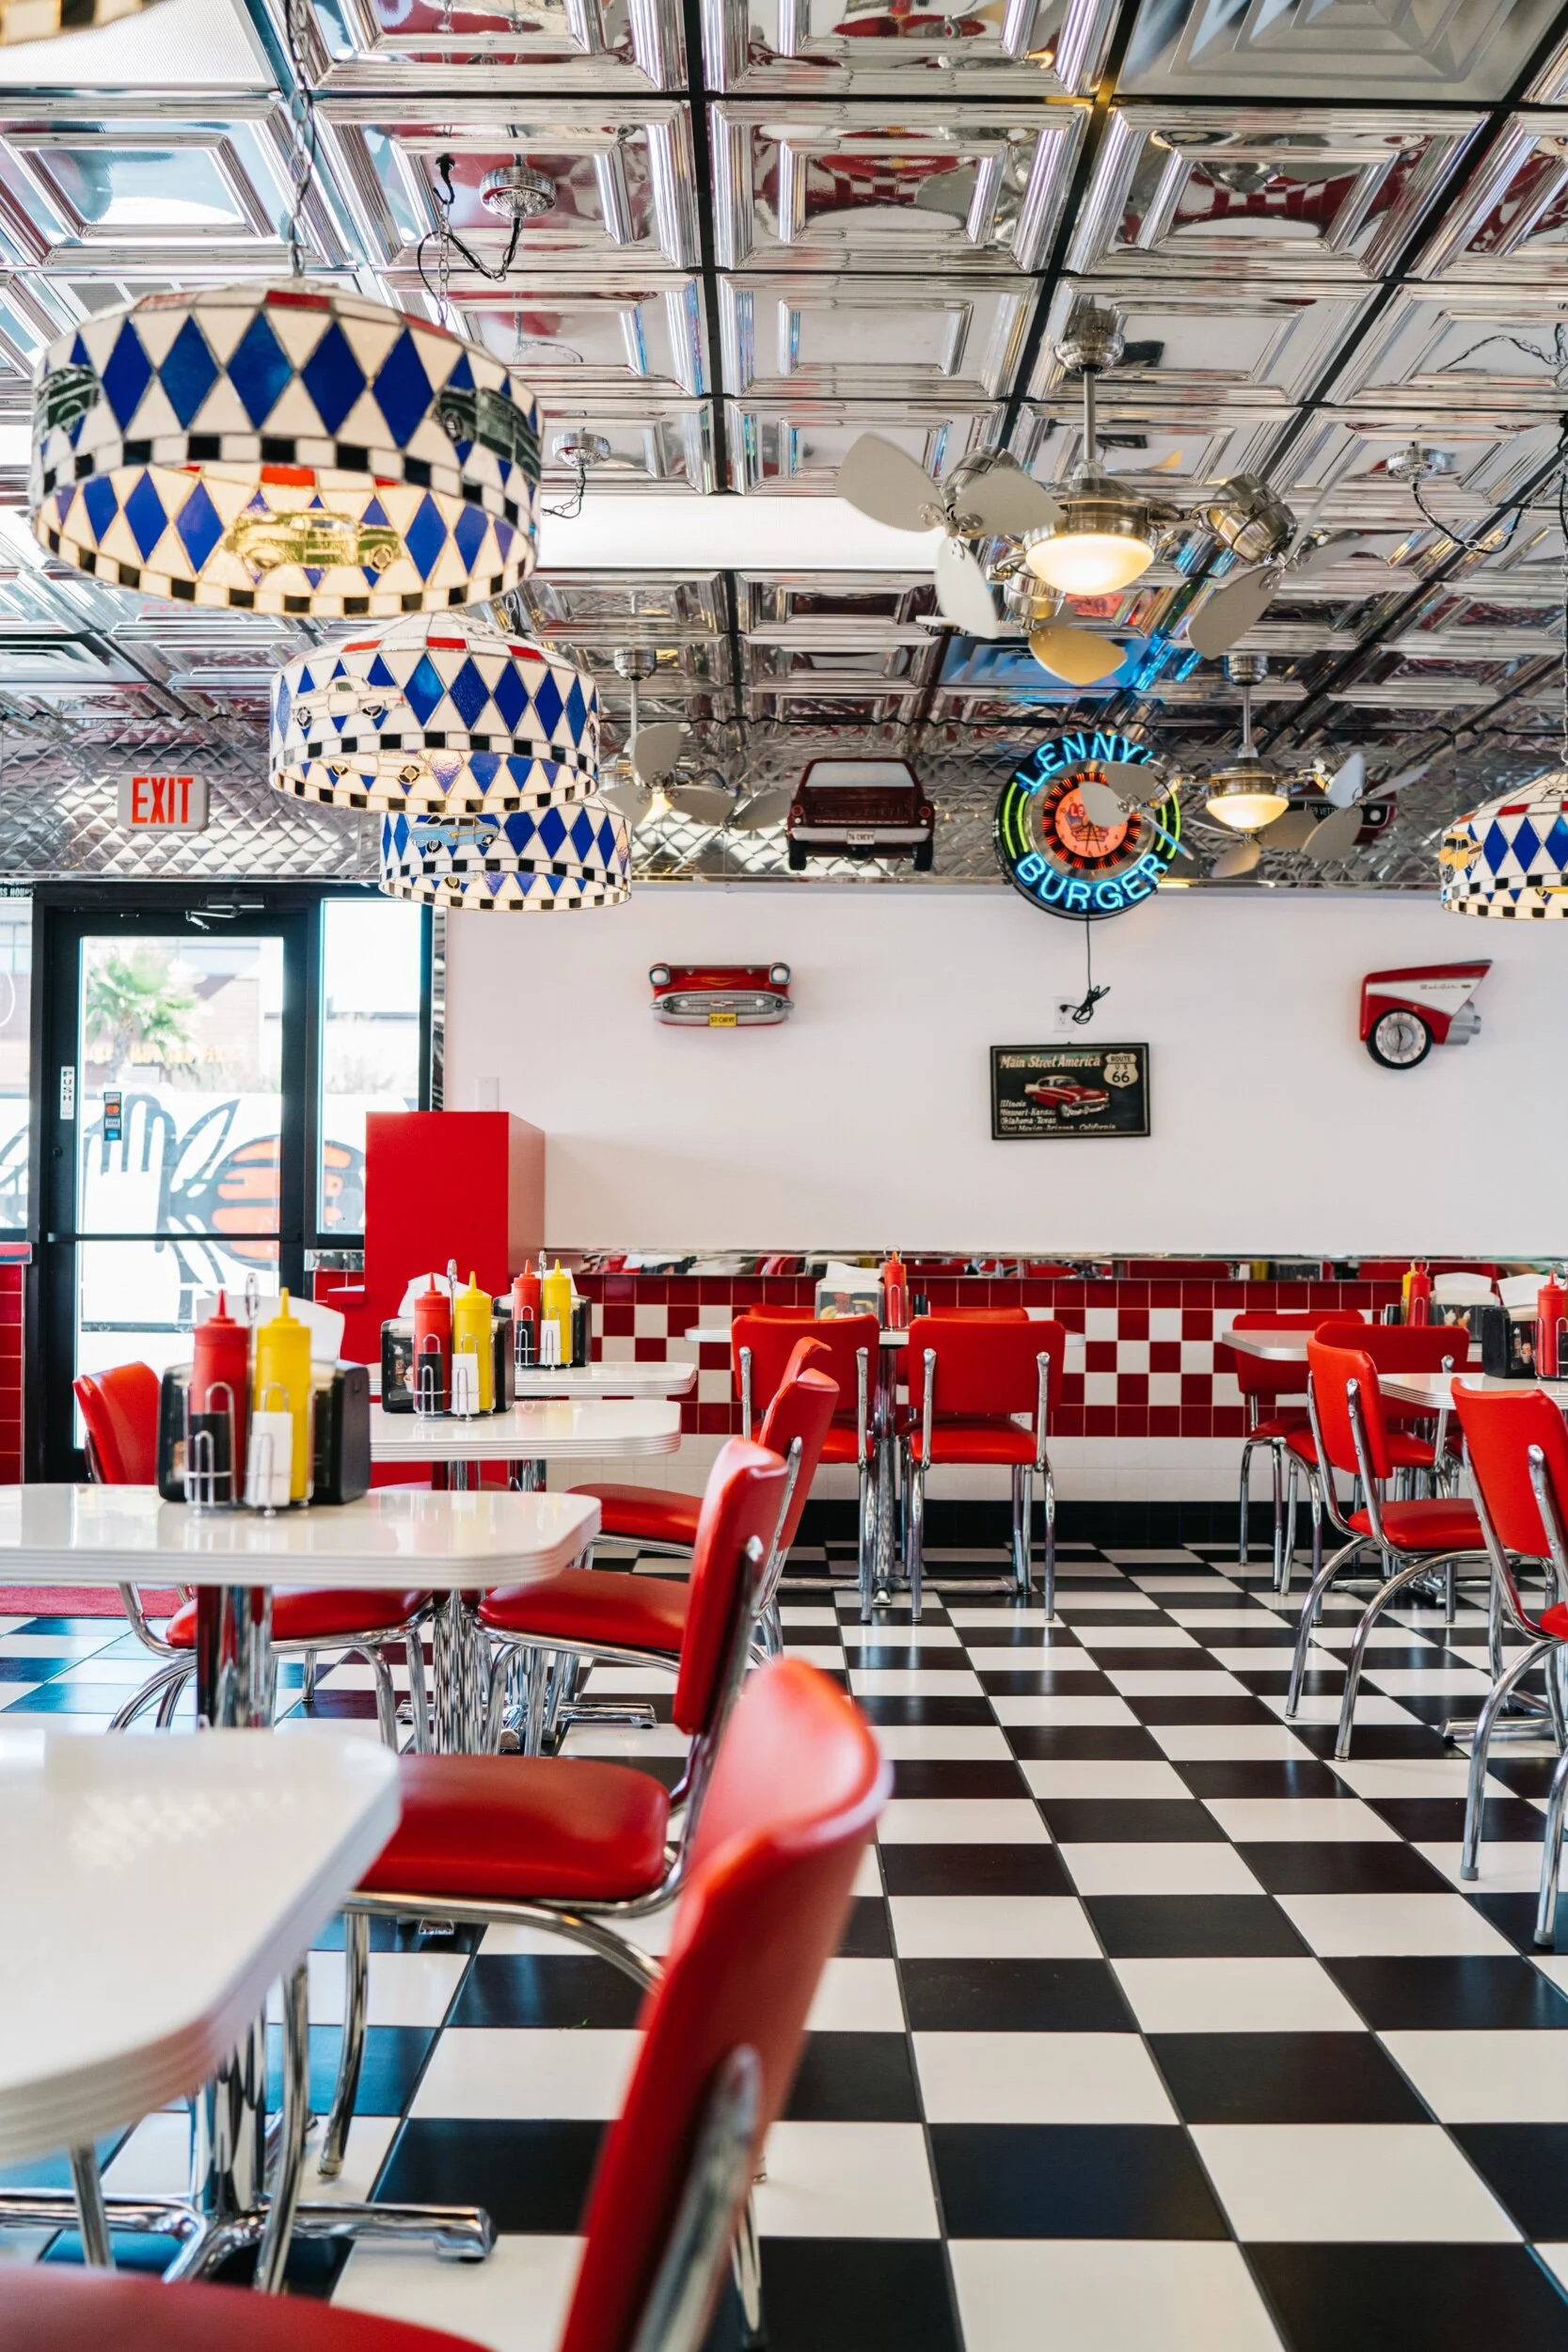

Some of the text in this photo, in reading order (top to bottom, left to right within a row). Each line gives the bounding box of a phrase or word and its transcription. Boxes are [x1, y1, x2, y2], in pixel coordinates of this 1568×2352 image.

[1015, 731, 1154, 795] LENNY'
[131, 776, 195, 824] EXIT
[1545, 787, 1568, 795] 6
[1016, 851, 1168, 910] BURGER
[9, 887, 34, 898] HOURS
[1001, 1054, 1101, 1069] Main Street America
[63, 1071, 73, 1102] PUSH
[1111, 1071, 1131, 1083] 66
